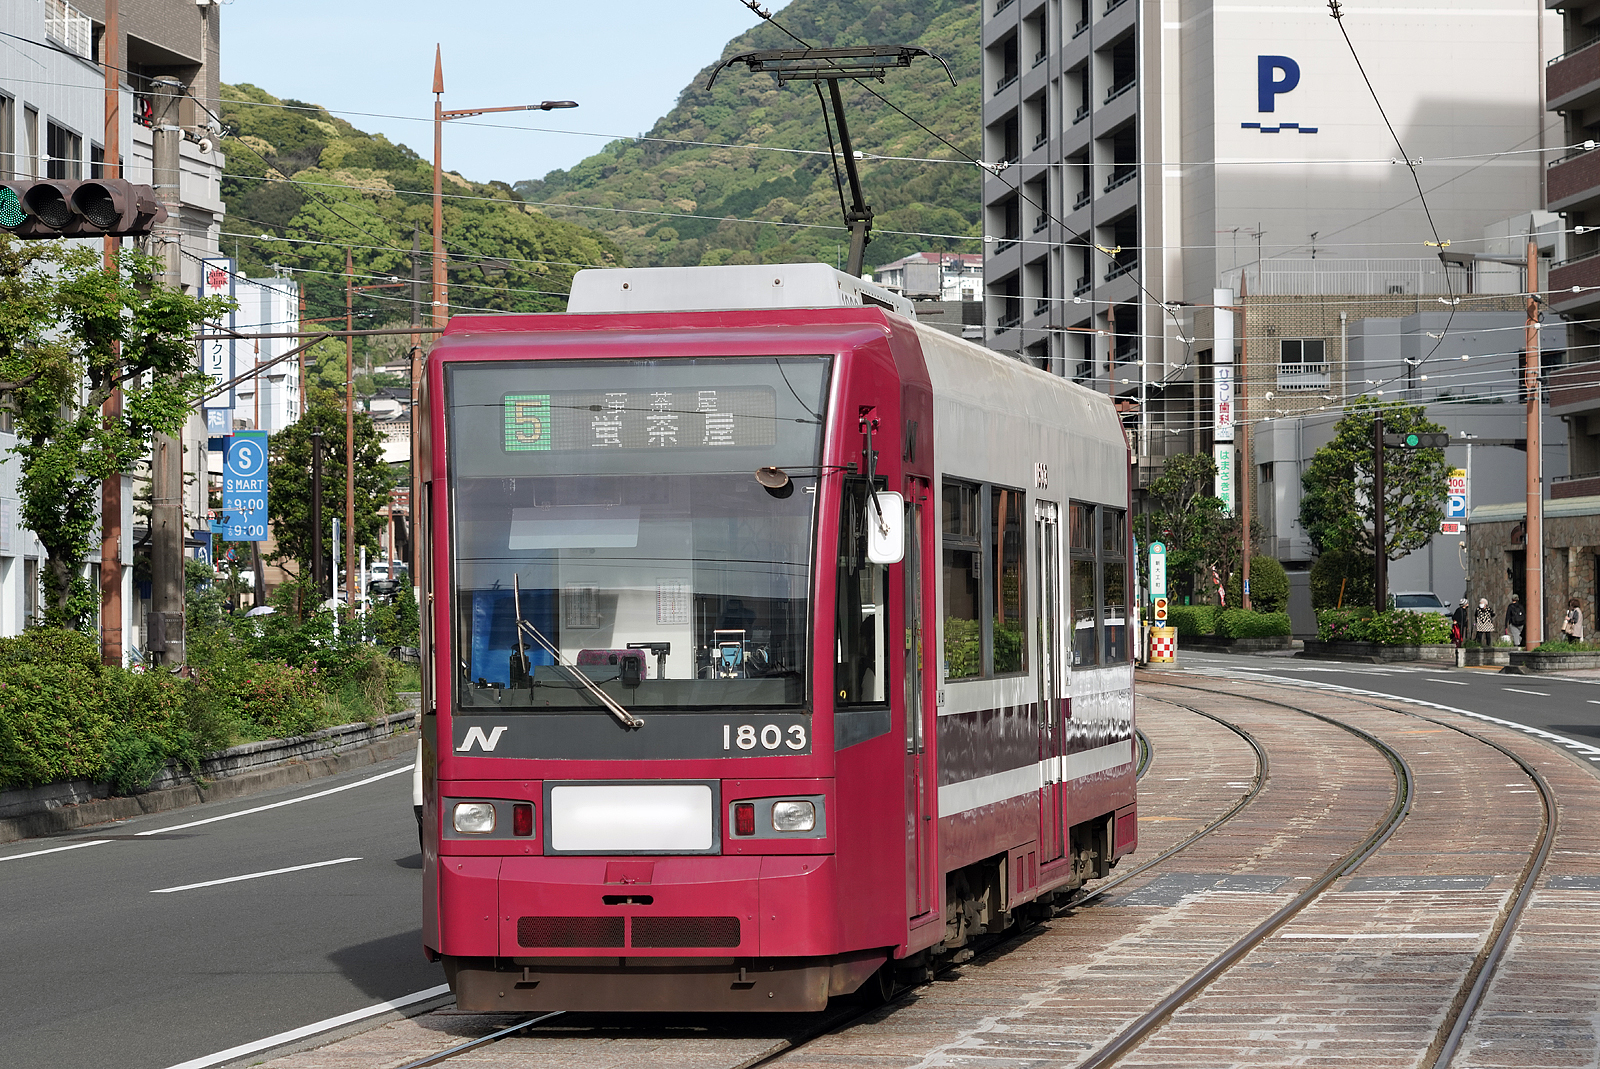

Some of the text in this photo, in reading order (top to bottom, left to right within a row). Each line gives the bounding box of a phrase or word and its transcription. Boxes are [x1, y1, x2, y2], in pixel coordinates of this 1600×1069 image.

[1258, 55, 1300, 112] P
[1219, 369, 1230, 425] ひろし歯科
[514, 401, 541, 443] 5
[238, 447, 251, 469] S
[234, 498, 264, 510] 9:00
[1448, 497, 1464, 516] P
[234, 524, 264, 536] 9:00
[723, 724, 806, 750] 1803
